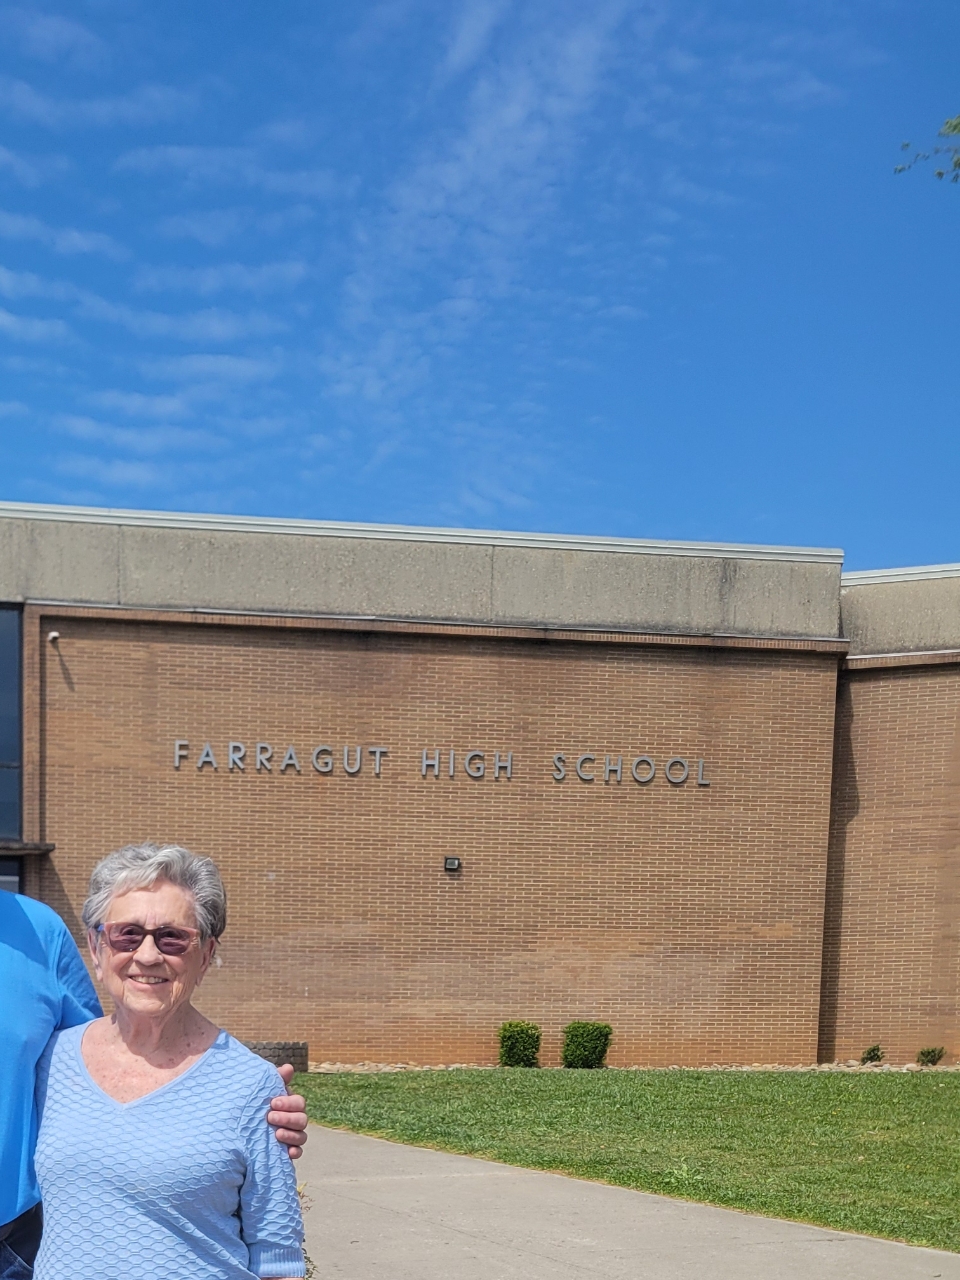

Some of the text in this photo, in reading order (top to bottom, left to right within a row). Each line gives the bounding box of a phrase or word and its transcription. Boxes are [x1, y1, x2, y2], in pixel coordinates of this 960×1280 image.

[173, 739, 711, 786] FARRAGUT HIGH SCHOOL
